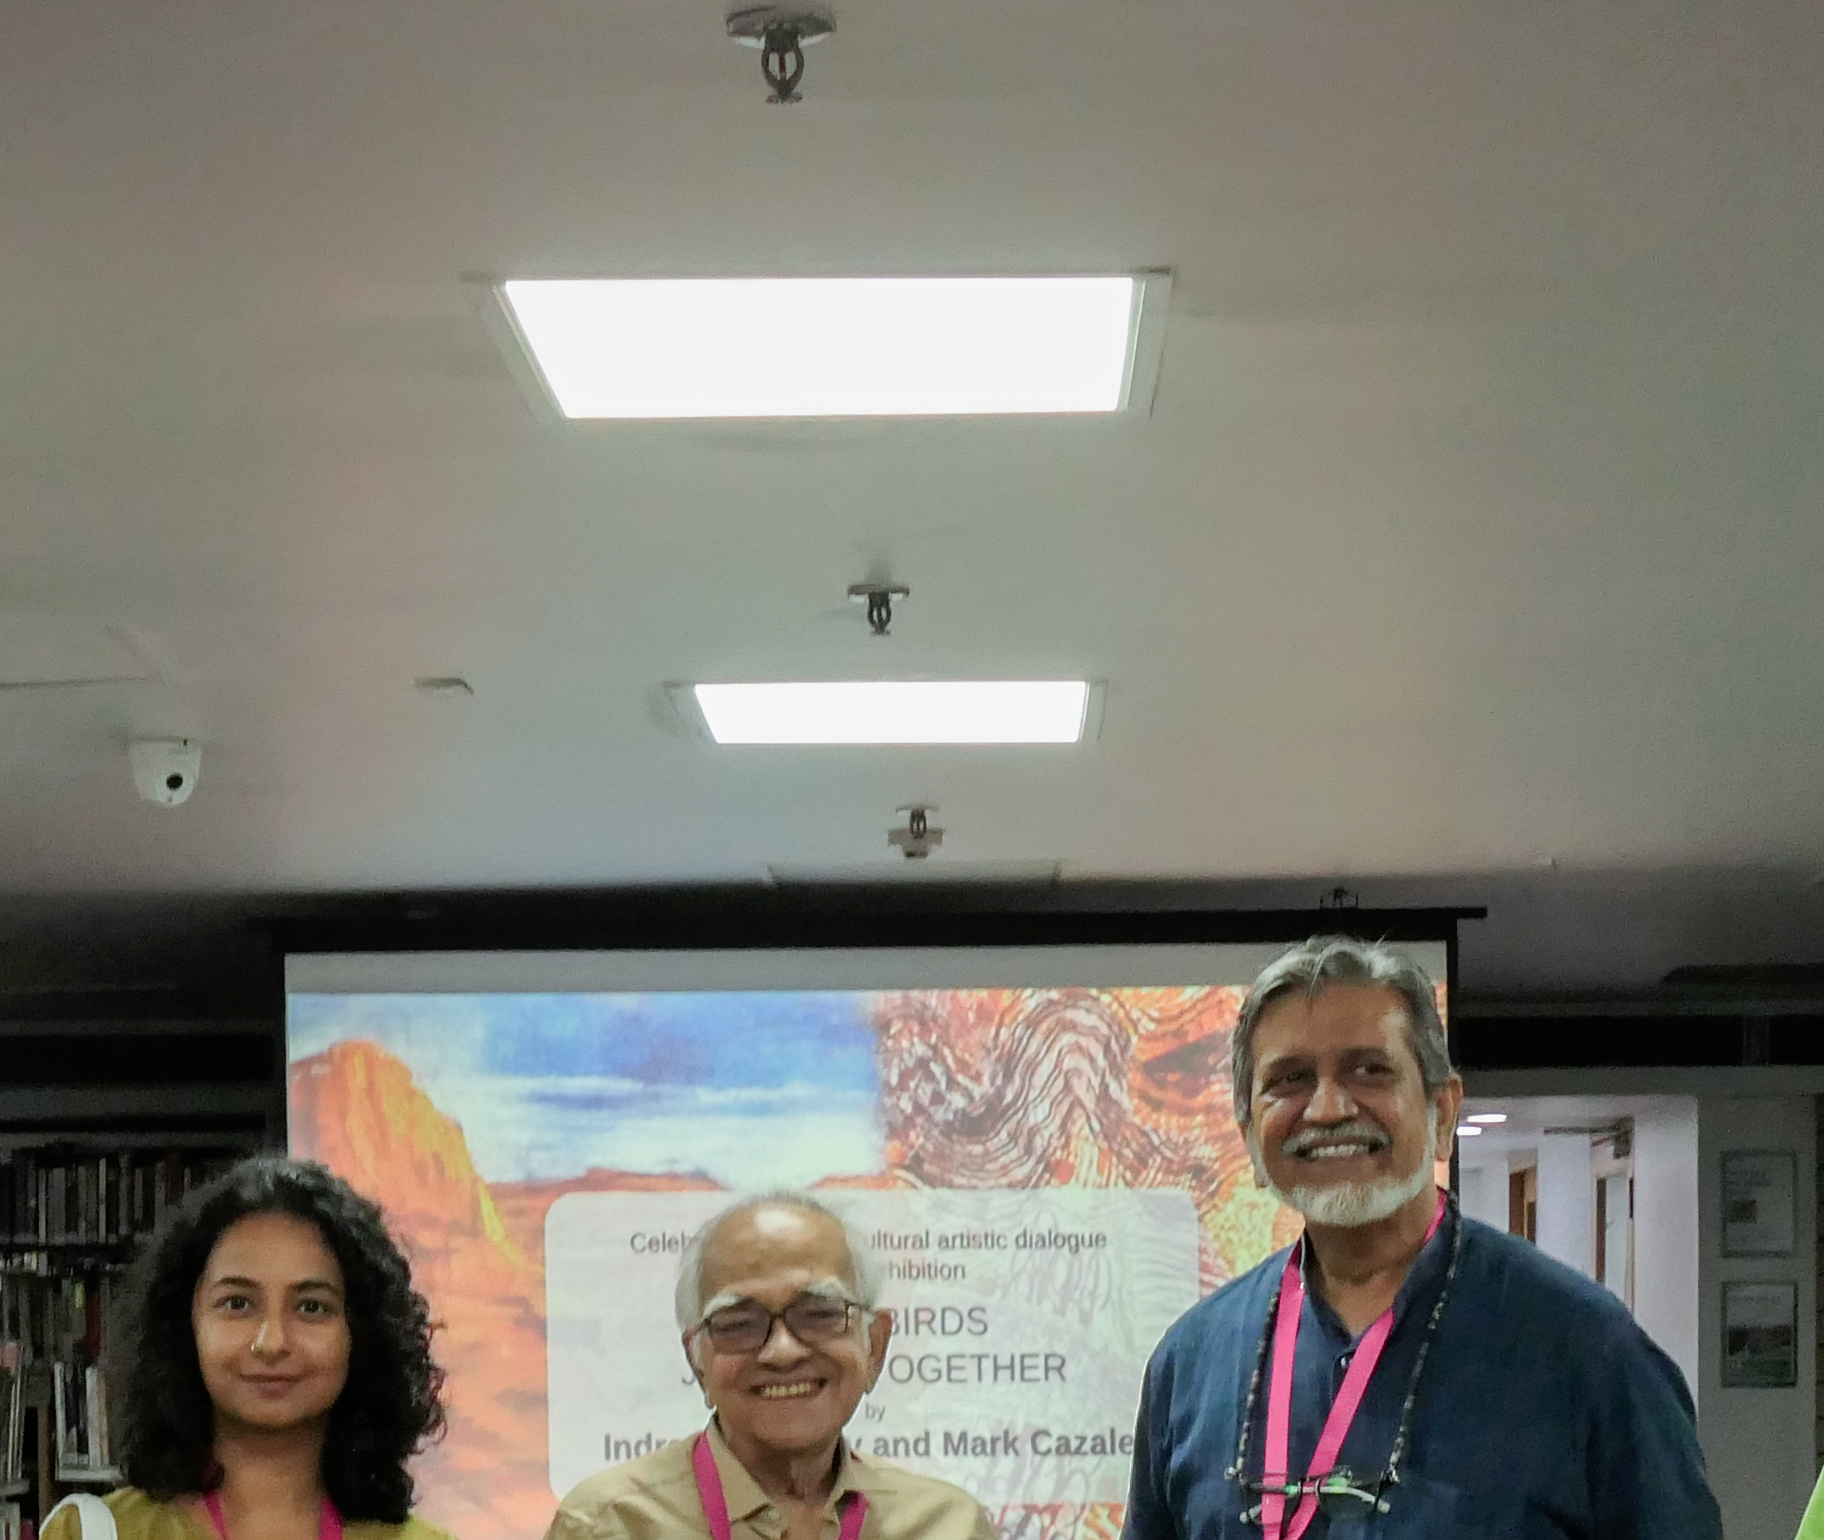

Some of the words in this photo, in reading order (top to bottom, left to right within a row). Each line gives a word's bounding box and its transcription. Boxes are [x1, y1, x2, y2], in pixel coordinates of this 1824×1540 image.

[937, 1229, 1008, 1250] artistic
[1014, 1228, 1108, 1253] dialogue
[888, 1352, 1068, 1384] OGETHER
[865, 1402, 887, 1422] by
[872, 1430, 931, 1458] and
[943, 1429, 1020, 1457] Mark
